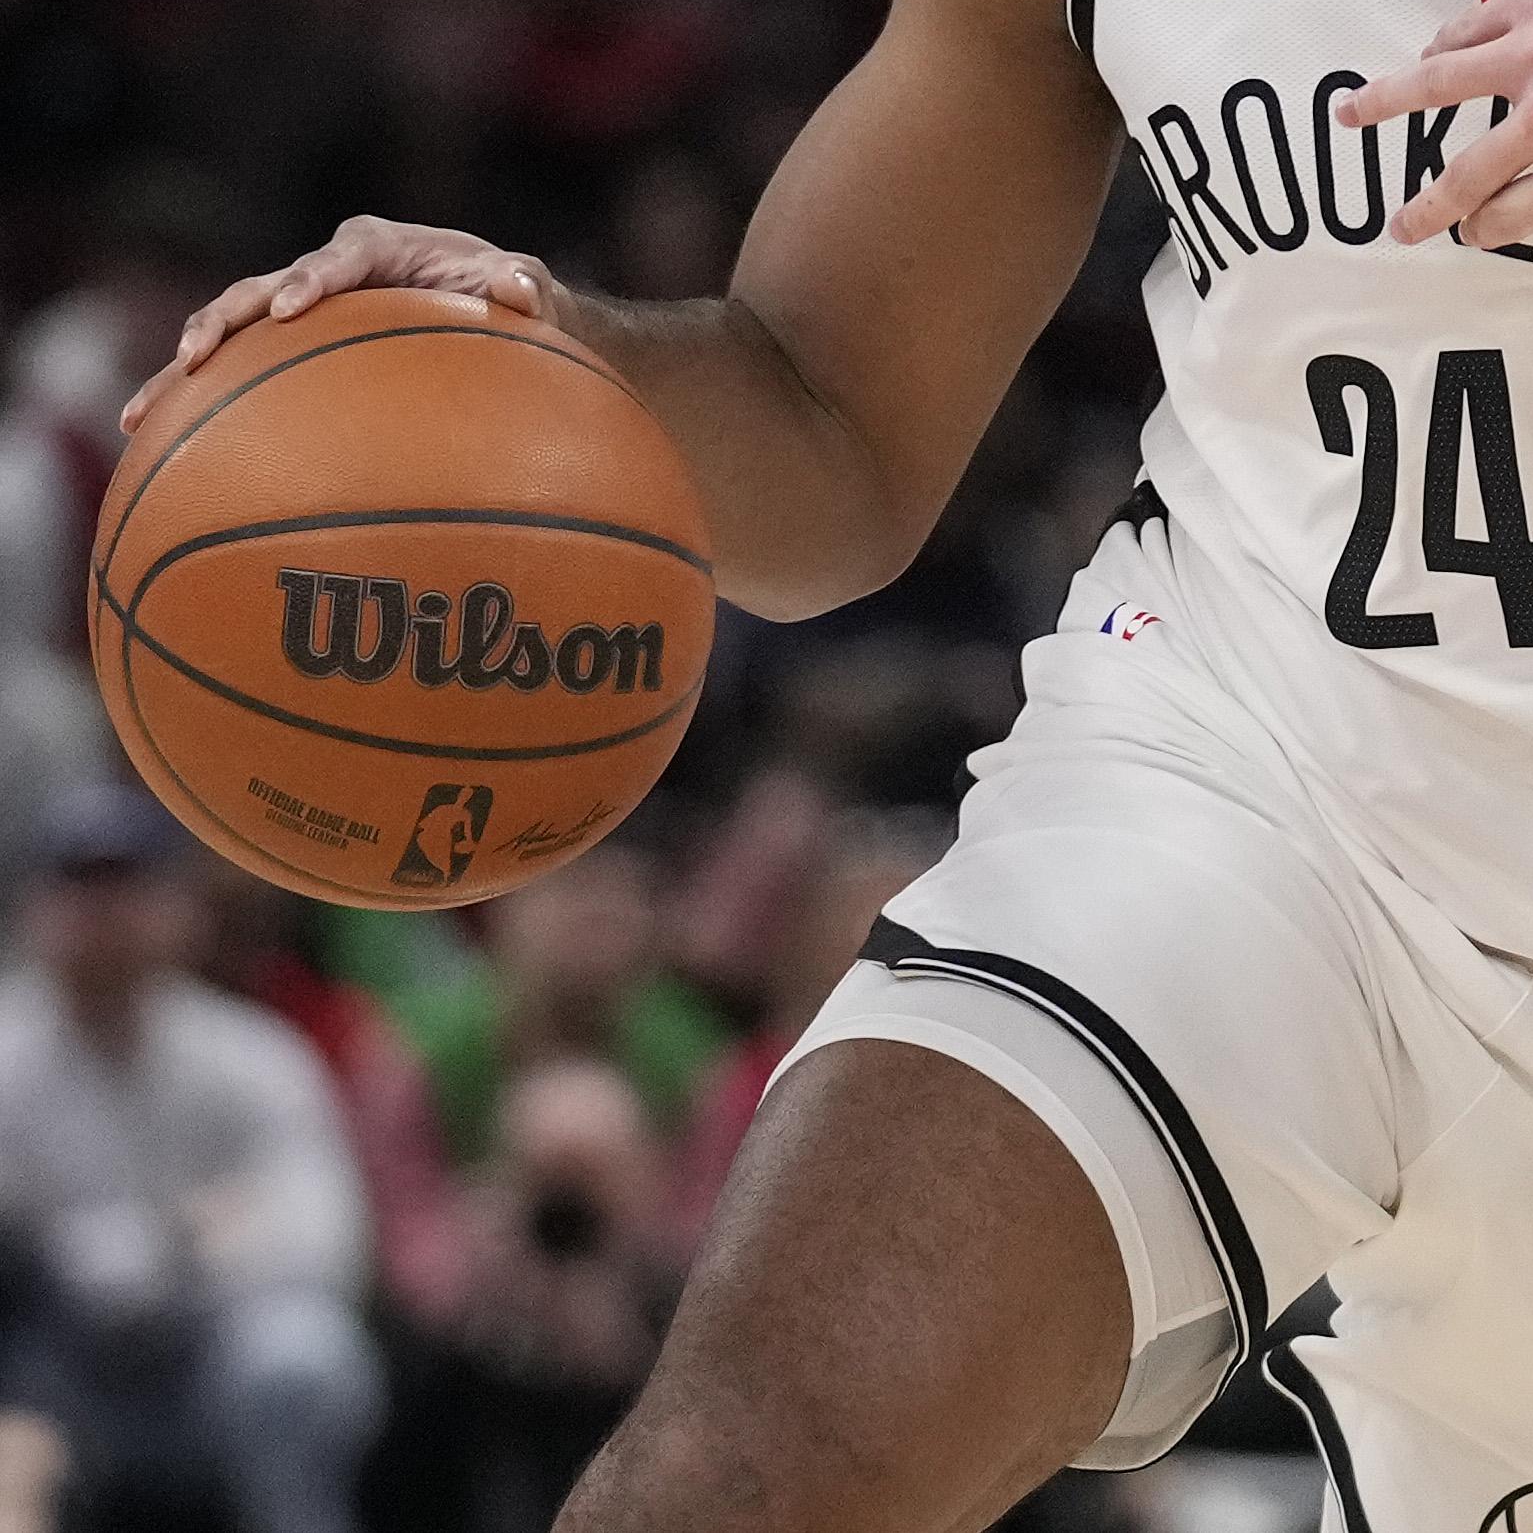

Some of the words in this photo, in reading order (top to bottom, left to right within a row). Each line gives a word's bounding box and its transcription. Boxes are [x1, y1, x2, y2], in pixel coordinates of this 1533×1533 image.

[277, 567, 666, 695] Wilson
[247, 777, 306, 818] OFFICIAL
[305, 806, 347, 833] GAME
[346, 820, 381, 846] BALL
